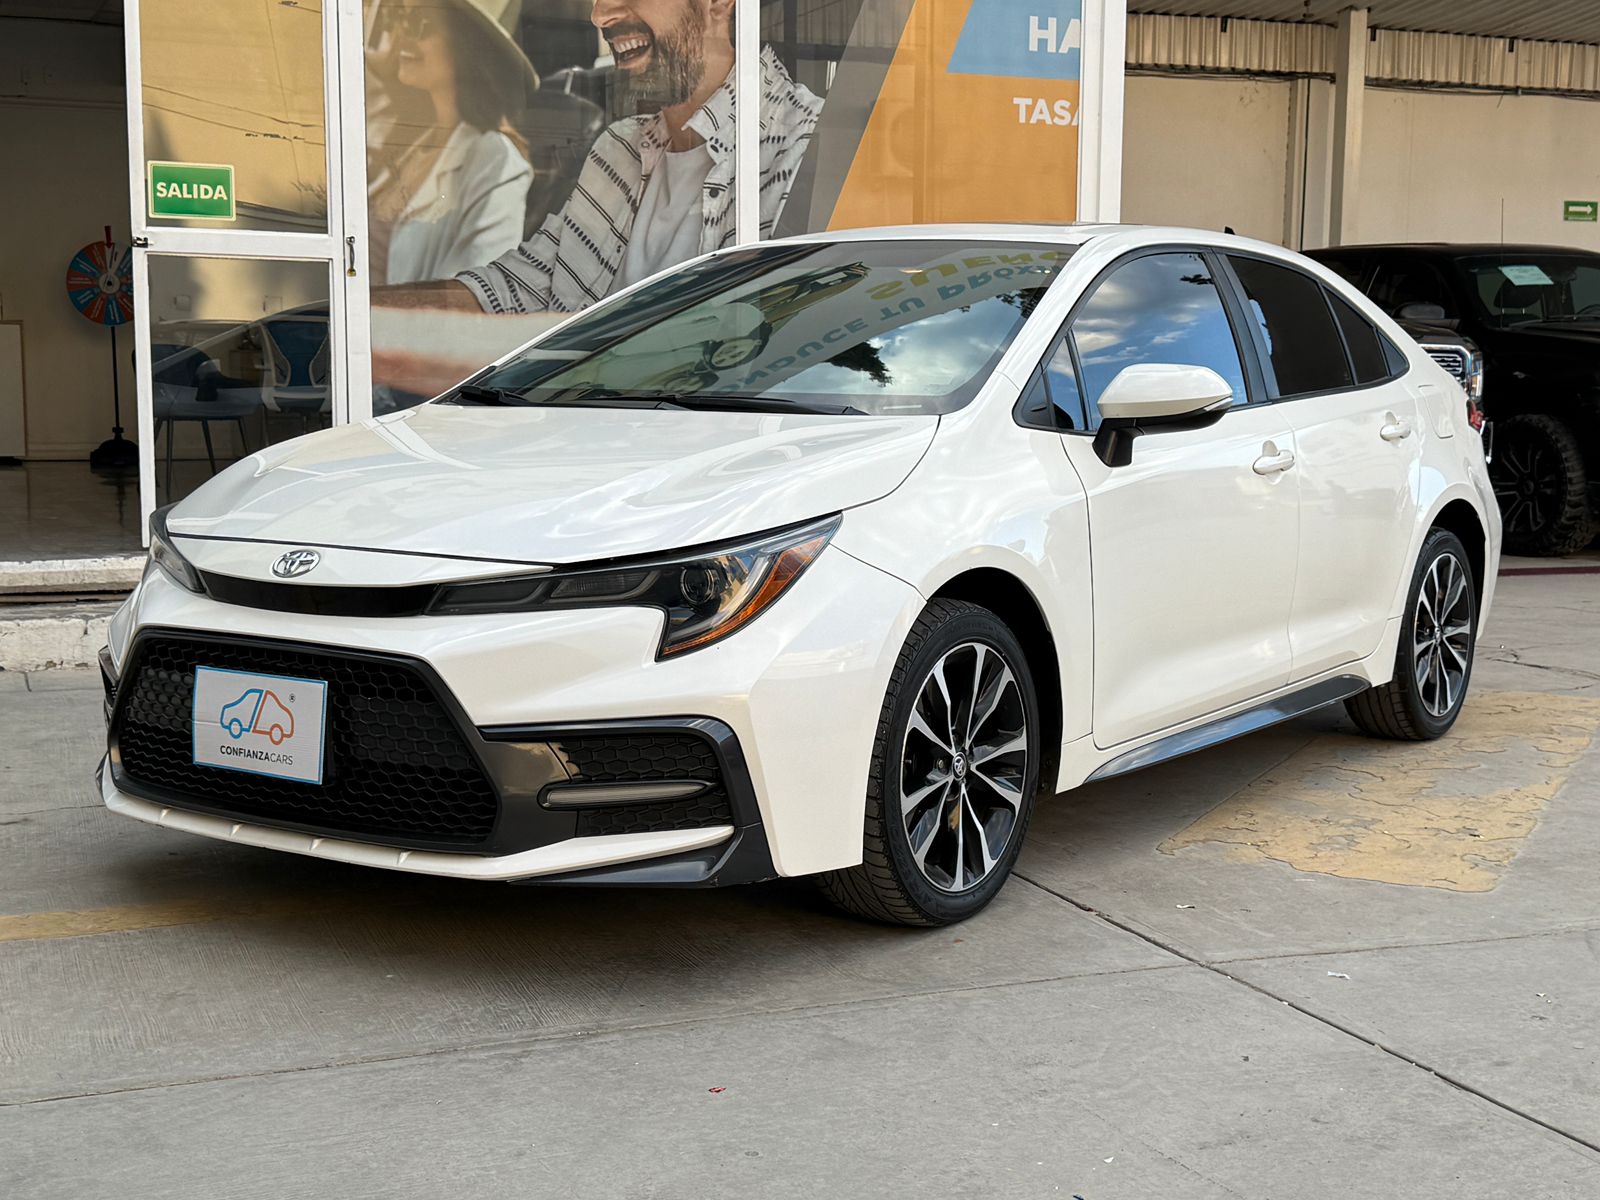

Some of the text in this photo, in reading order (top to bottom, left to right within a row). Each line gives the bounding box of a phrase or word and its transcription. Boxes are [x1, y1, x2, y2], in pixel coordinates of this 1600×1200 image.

[1012, 97, 1079, 126] TAS
[156, 181, 228, 200] SALIDA
[219, 744, 294, 766] CONFIANZACARS
